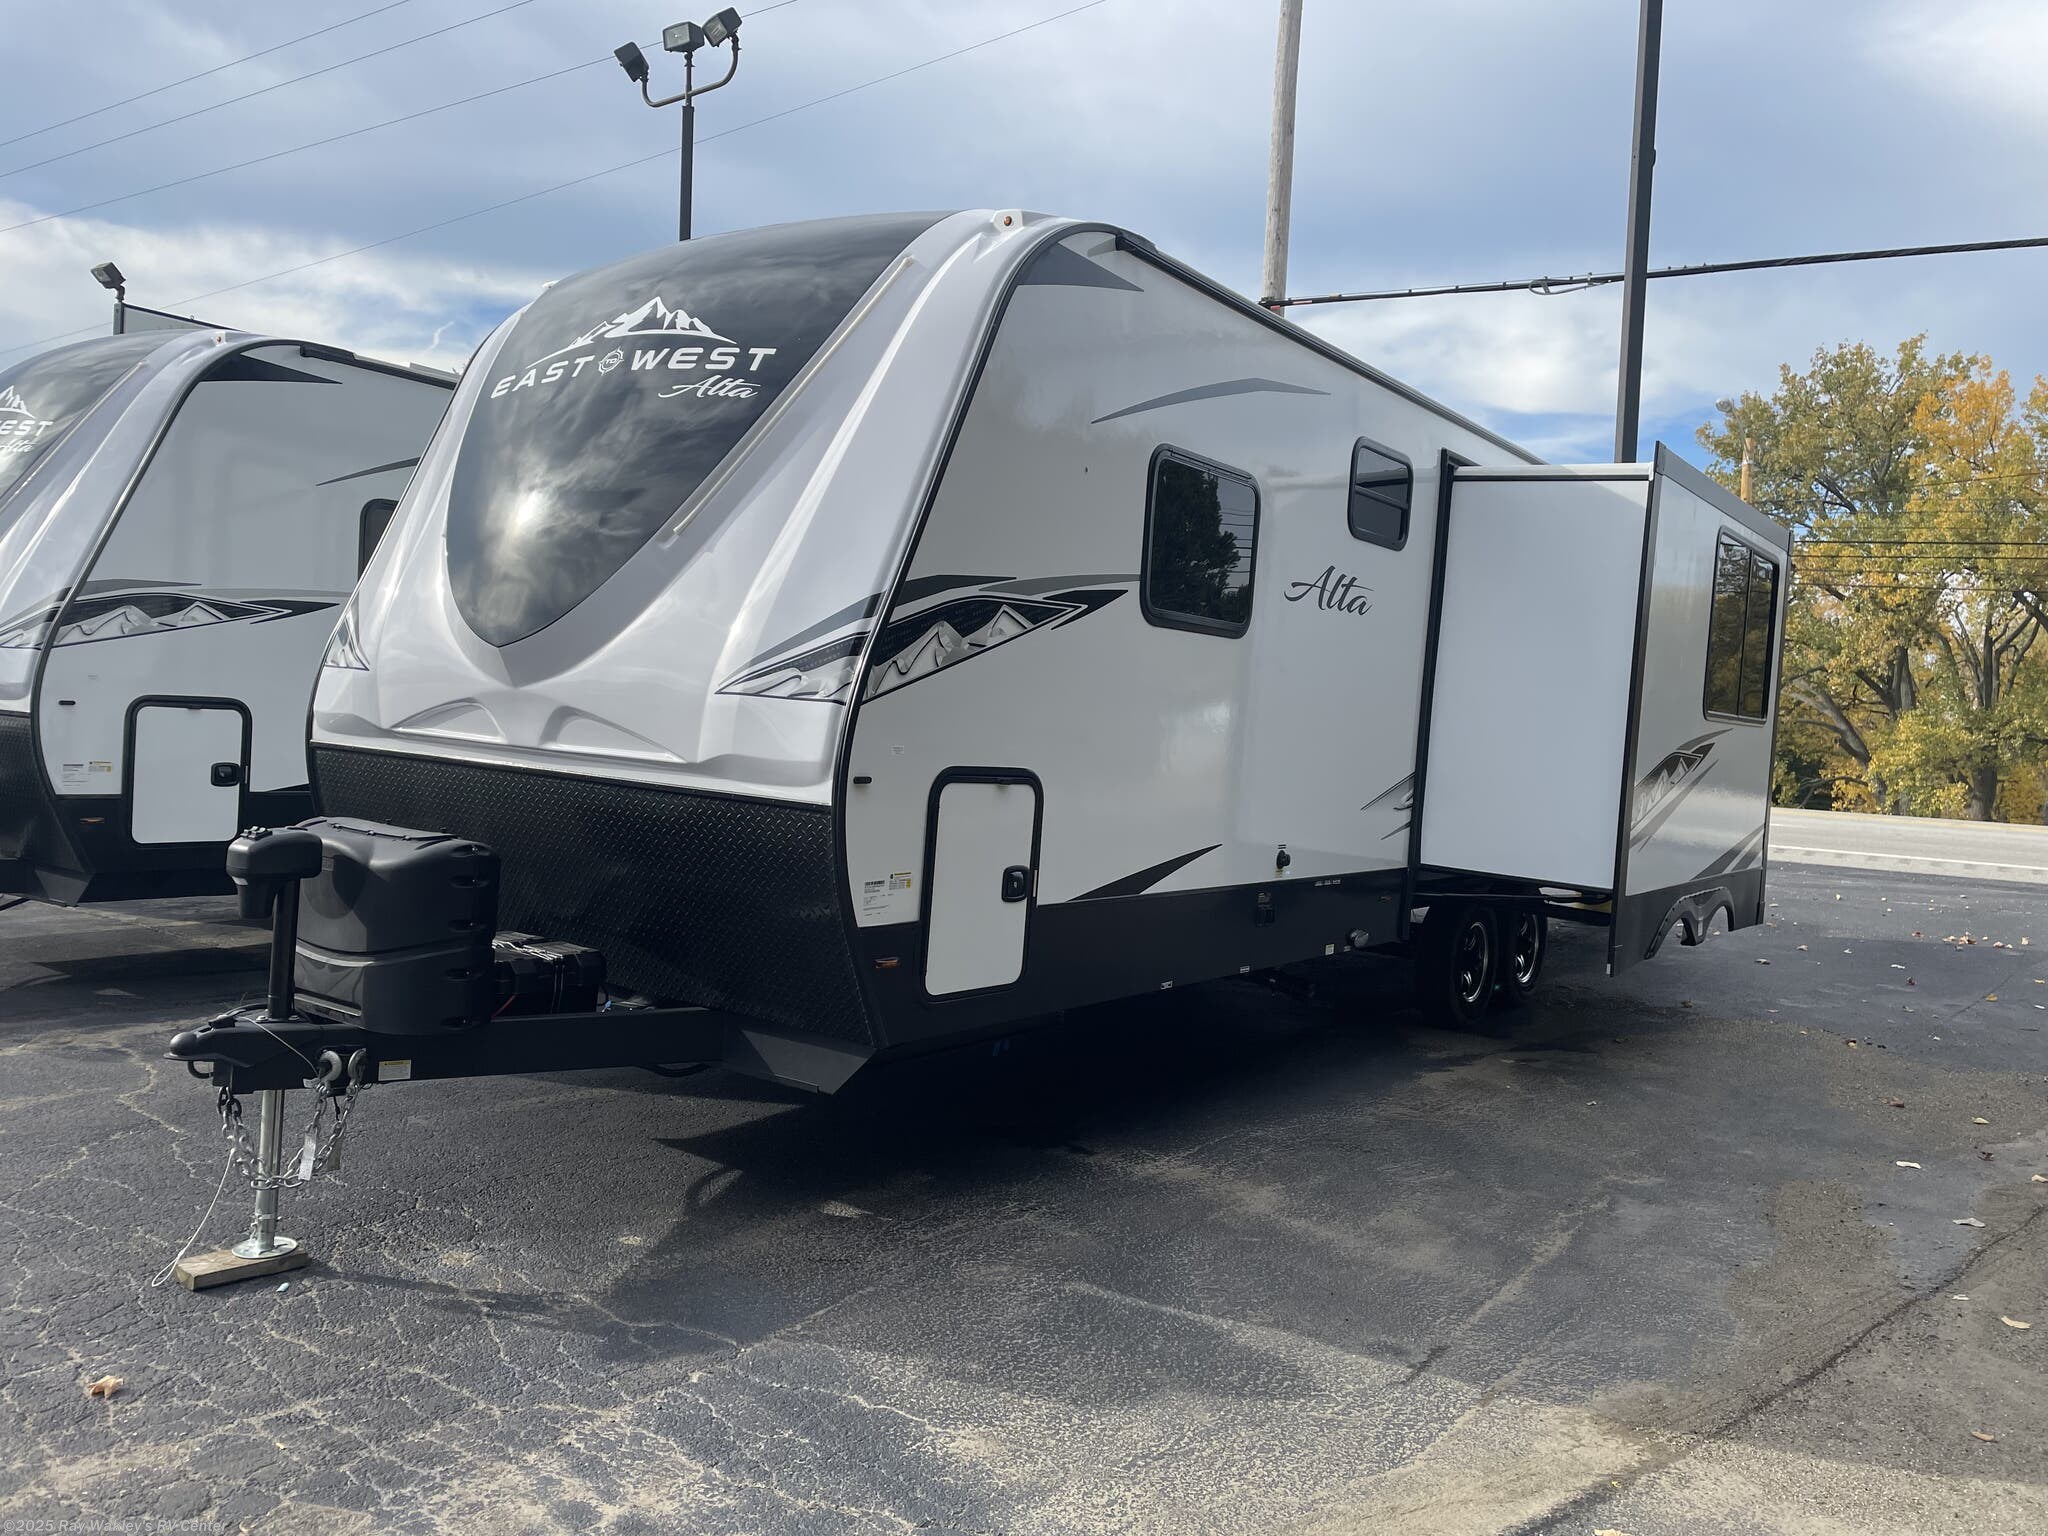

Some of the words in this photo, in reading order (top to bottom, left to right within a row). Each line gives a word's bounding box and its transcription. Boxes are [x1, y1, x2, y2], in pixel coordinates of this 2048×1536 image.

[490, 355, 596, 399] EAST
[630, 347, 777, 371] WEST
[657, 374, 761, 399] Alta
[0, 419, 54, 437] EST
[1283, 564, 1375, 616] Alta
